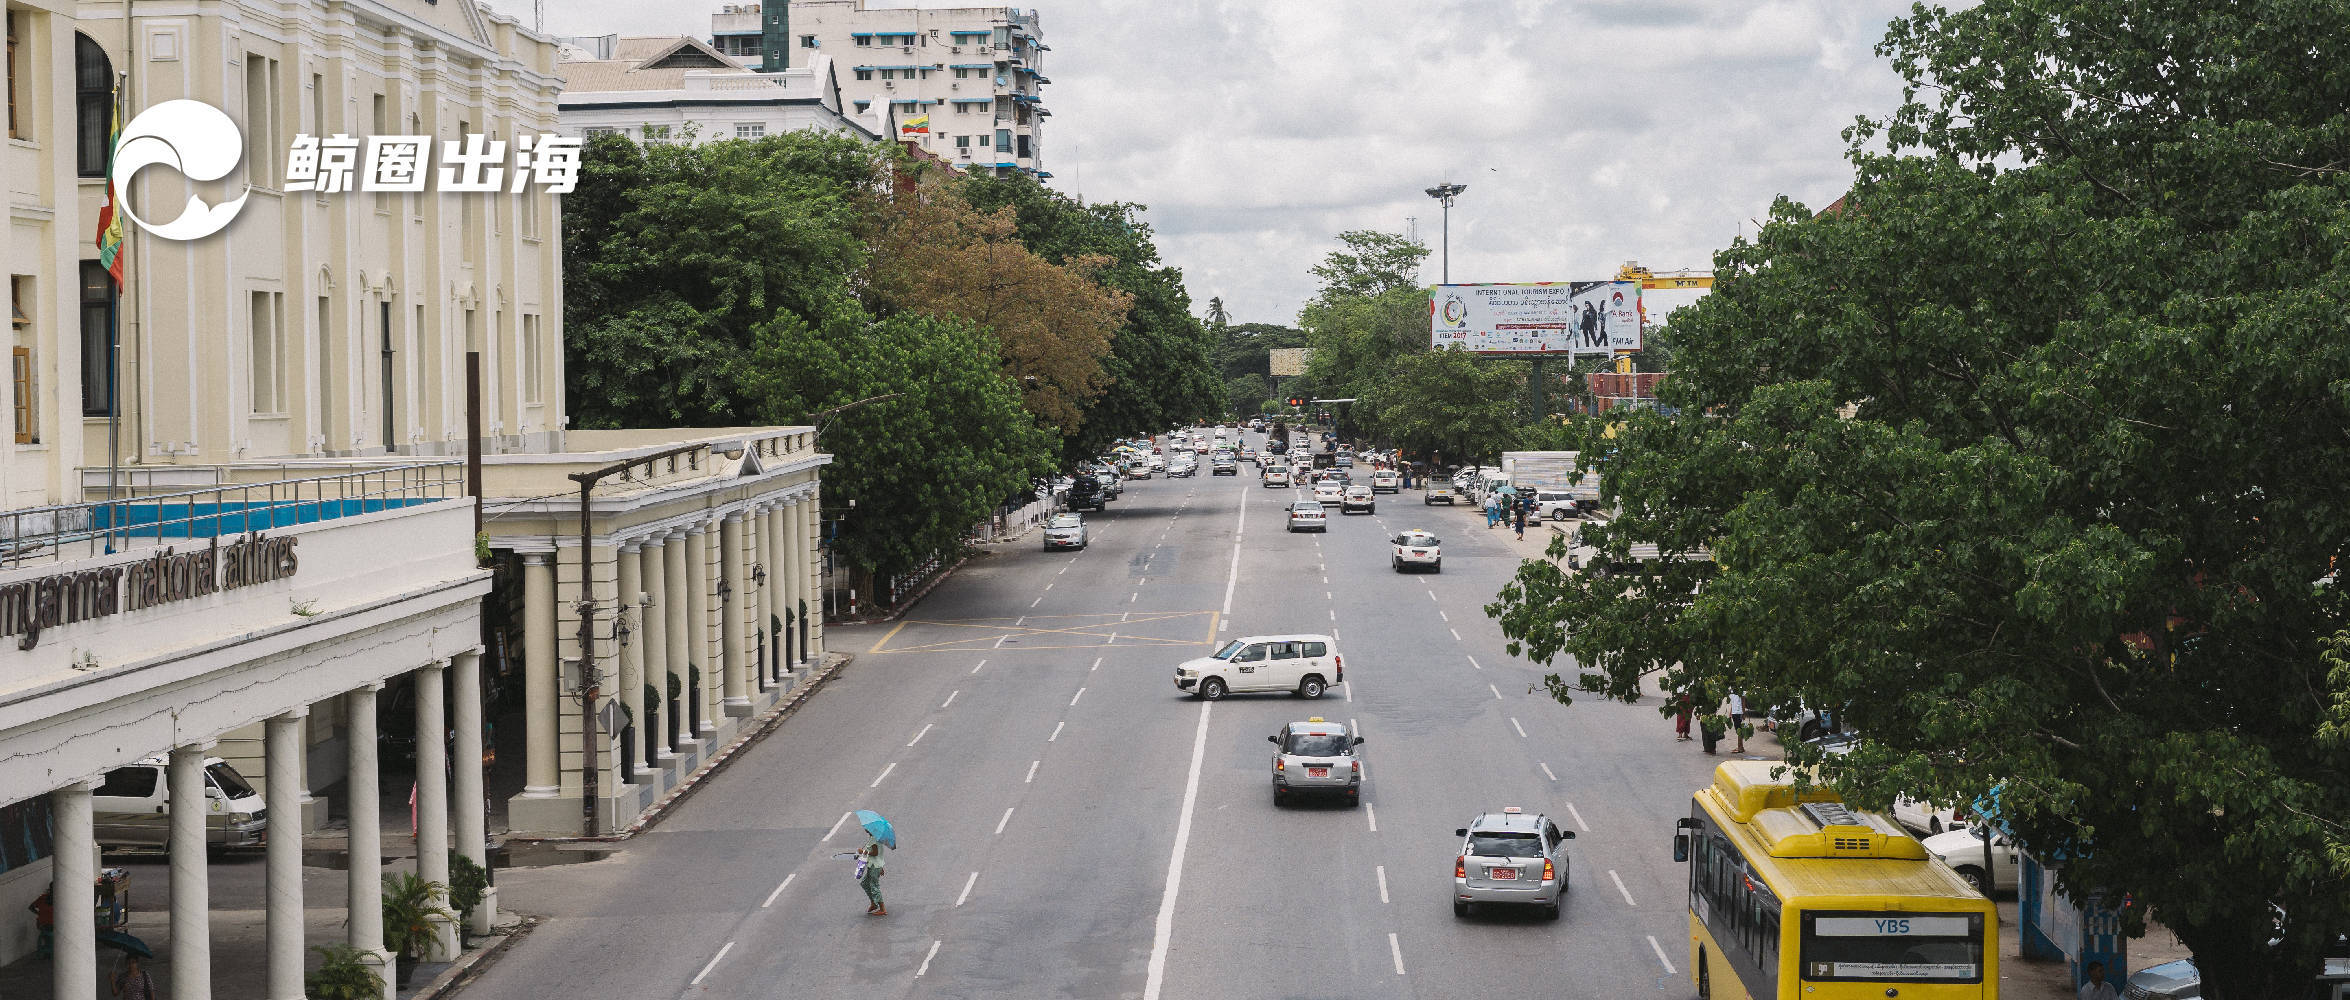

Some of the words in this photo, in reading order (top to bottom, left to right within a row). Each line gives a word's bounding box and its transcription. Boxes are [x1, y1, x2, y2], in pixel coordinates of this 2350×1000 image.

[0, 567, 123, 650] myanmar
[124, 537, 219, 612] national
[222, 531, 298, 591] airlines
[1874, 919, 1910, 934] YBS
